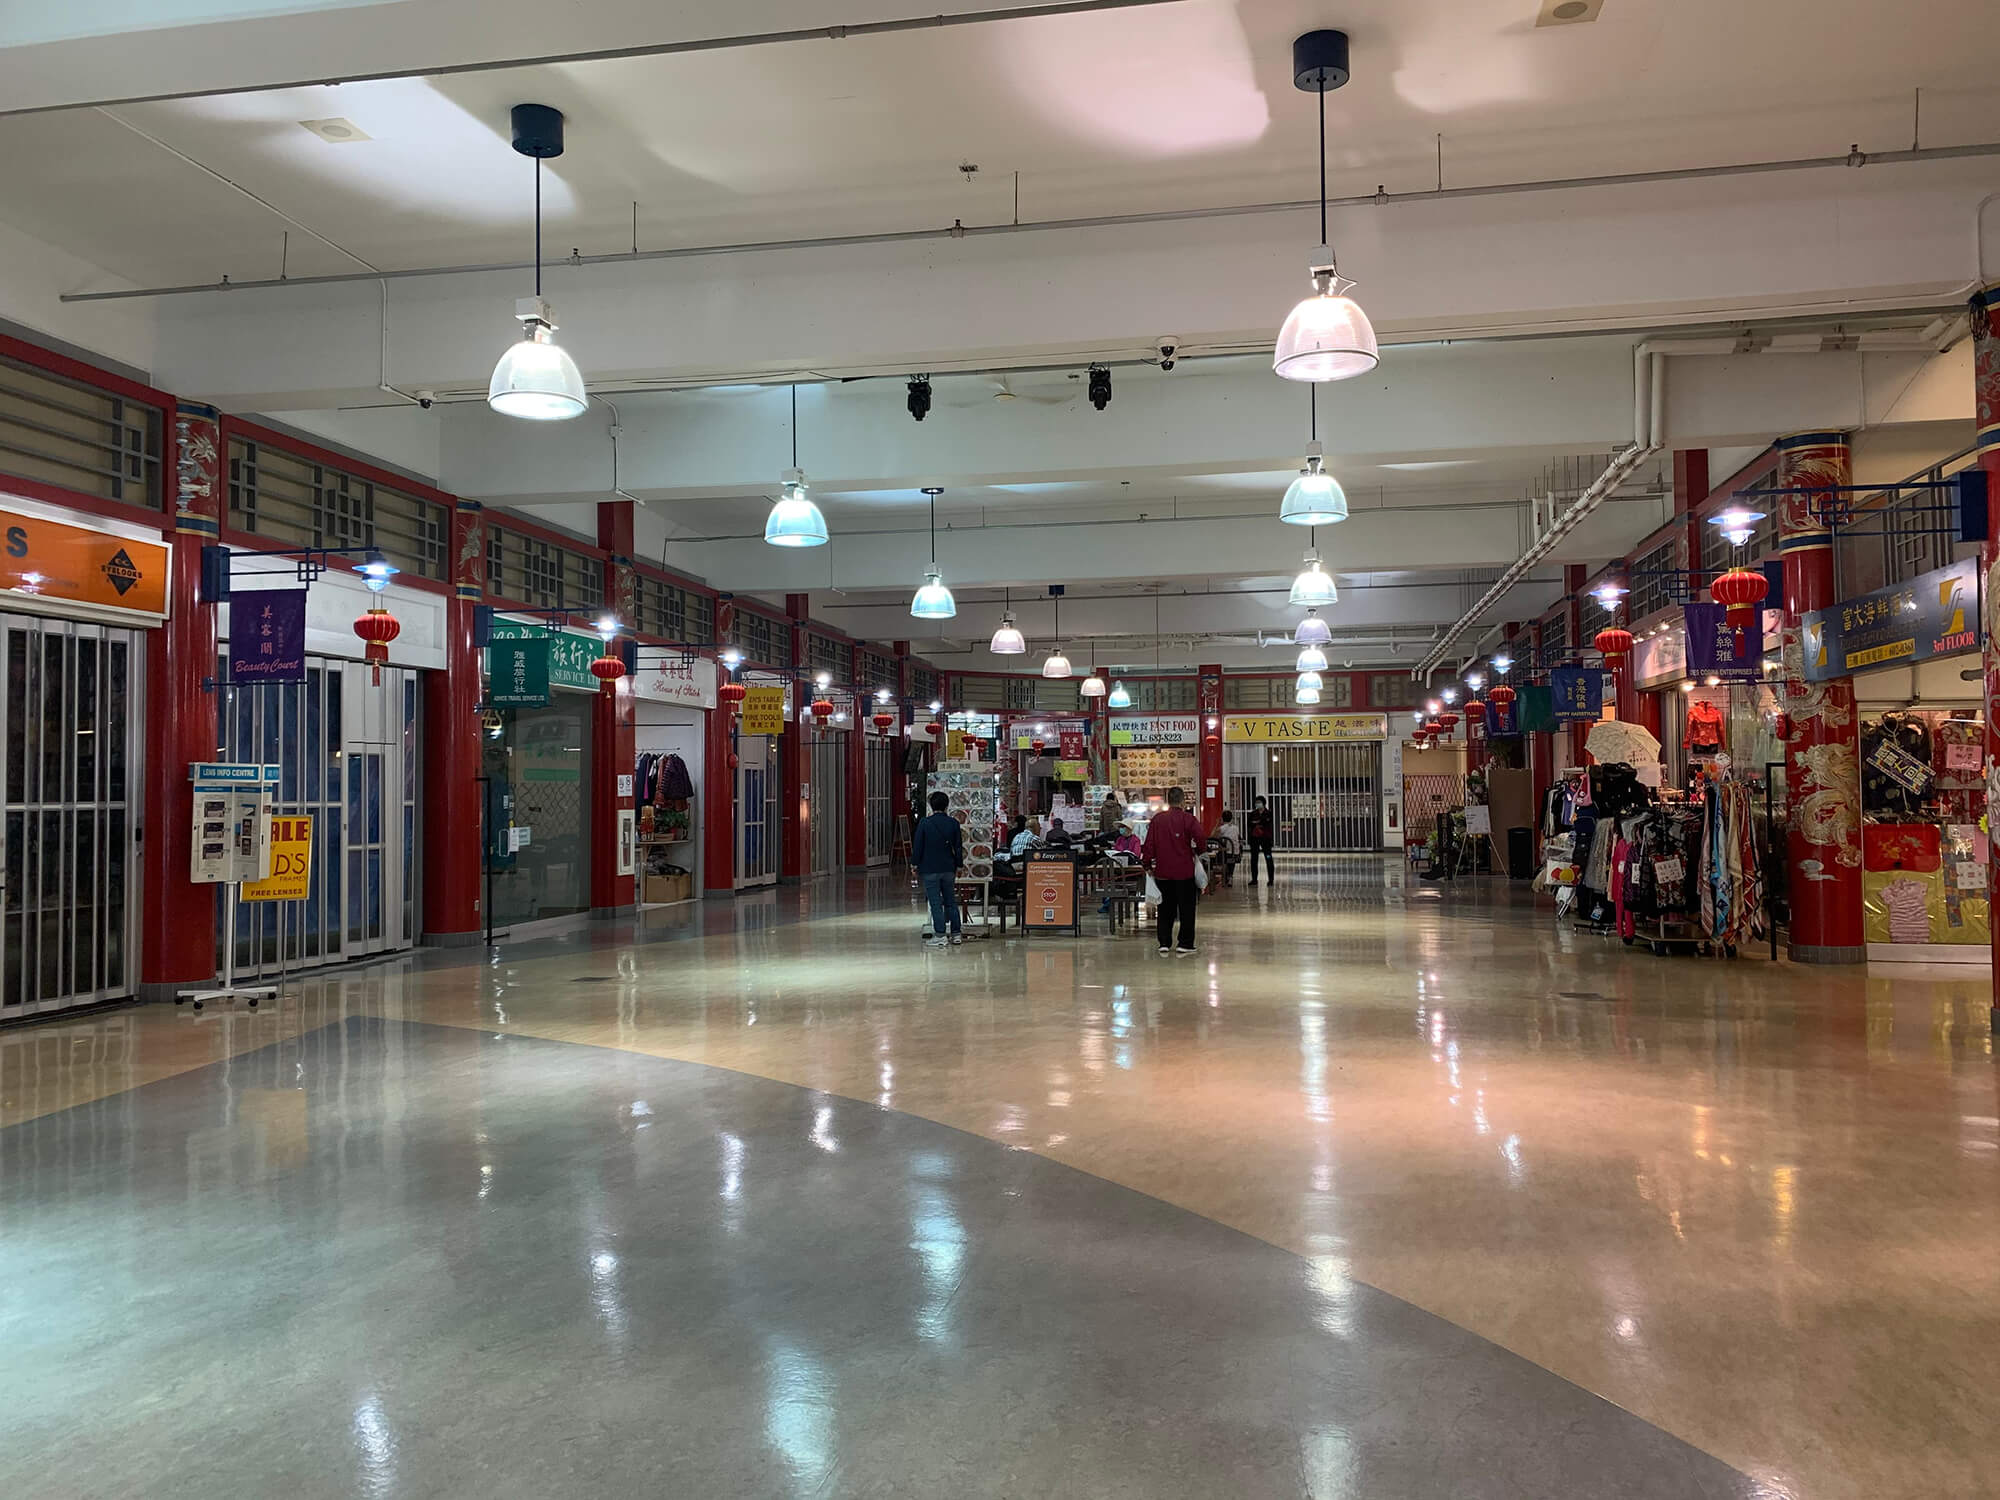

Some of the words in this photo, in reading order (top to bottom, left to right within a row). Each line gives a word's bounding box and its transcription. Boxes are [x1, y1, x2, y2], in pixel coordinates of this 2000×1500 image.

[100, 563, 143, 579] EYELOOKS
[1932, 639, 1945, 652] 3rd
[1946, 631, 1976, 650] FLOOR
[235, 659, 271, 673] Beauty
[269, 658, 299, 673] Court
[554, 669, 585, 683] SERVICE
[1150, 720, 1171, 731] FAST
[1172, 720, 1197, 731] FOOD
[1244, 721, 1257, 737] V
[1263, 720, 1331, 737] TASTE
[216, 768, 231, 777] INFO
[231, 769, 255, 777] CENTRE
[270, 820, 309, 843] ALE
[250, 889, 271, 897] FREE
[272, 887, 303, 896] LENSES
